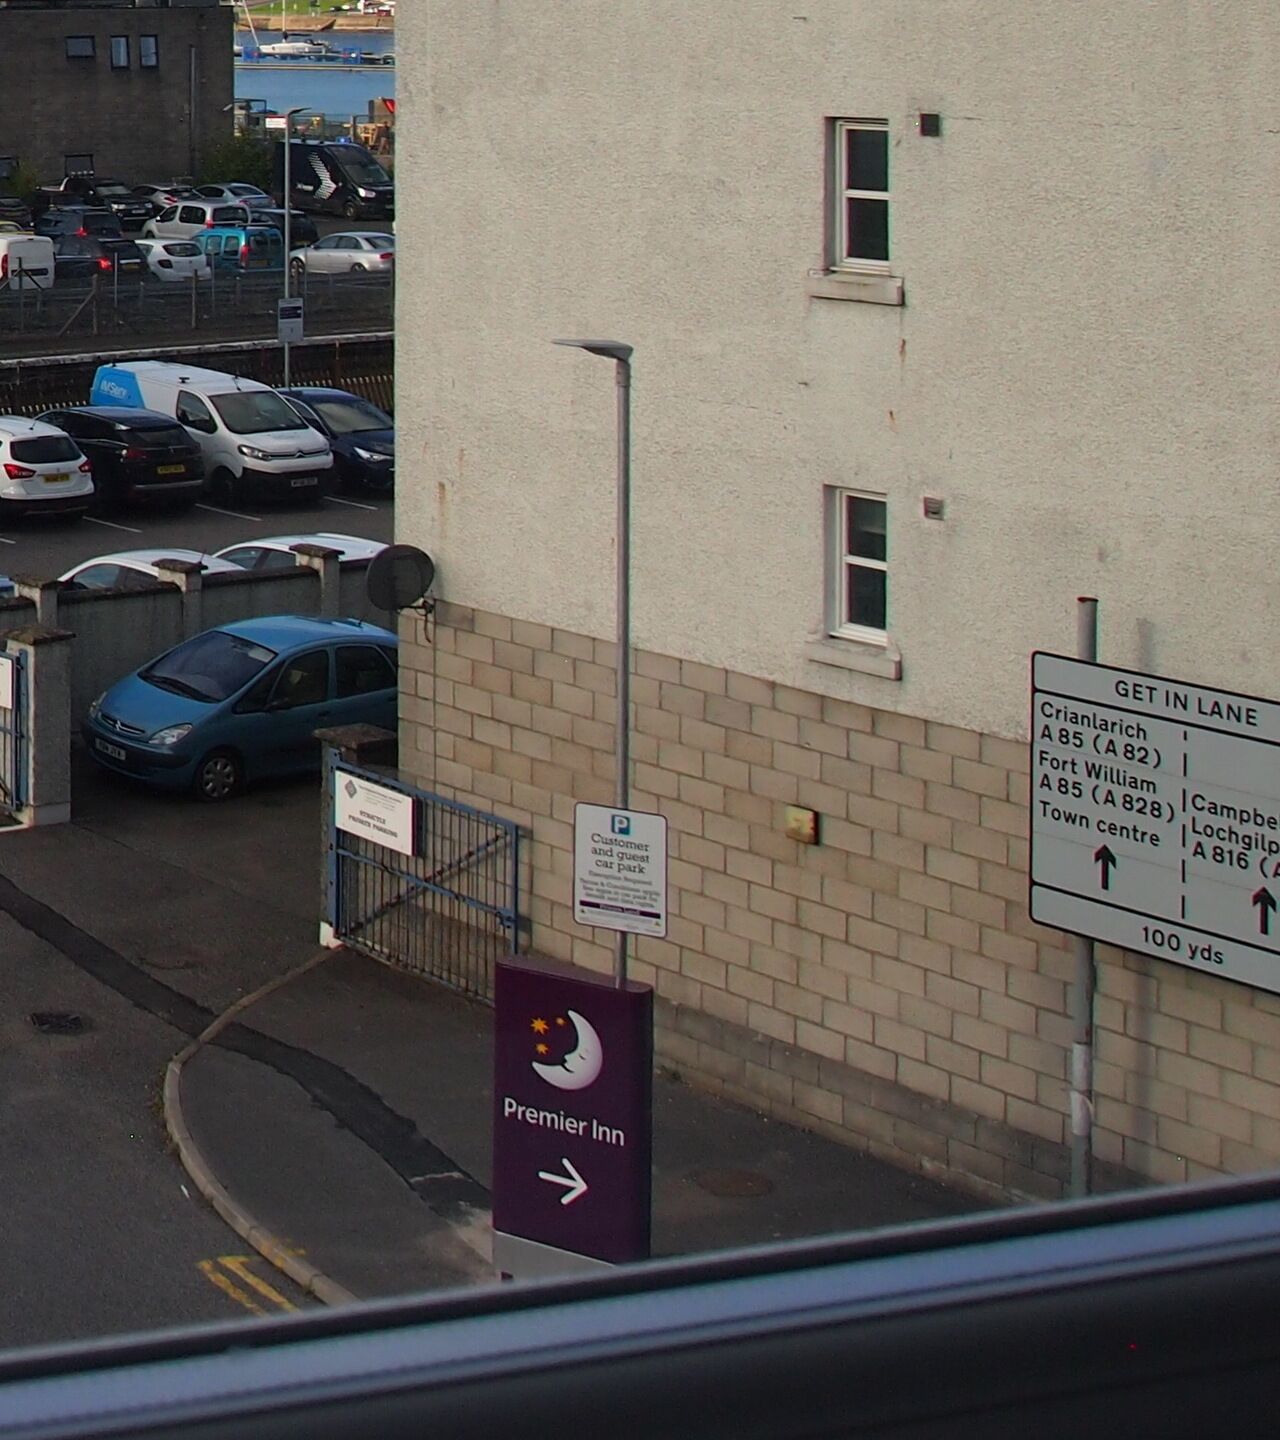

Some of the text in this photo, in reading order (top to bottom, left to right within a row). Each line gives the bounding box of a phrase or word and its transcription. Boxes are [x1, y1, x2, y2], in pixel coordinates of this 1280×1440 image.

[1041, 702, 1147, 741] Crianlarich
[1115, 680, 1259, 727] GET IN LANE
[1040, 751, 1157, 794] Fort William
[1040, 800, 1160, 847] Town centre
[1192, 794, 1280, 830] Campbe
[591, 833, 650, 852] Customer
[591, 846, 650, 864] and guest
[1192, 816, 1280, 856] Lochgilp
[595, 859, 646, 874] car park
[1142, 926, 1224, 964] 100 yds
[504, 1096, 625, 1146] Premier Inn
